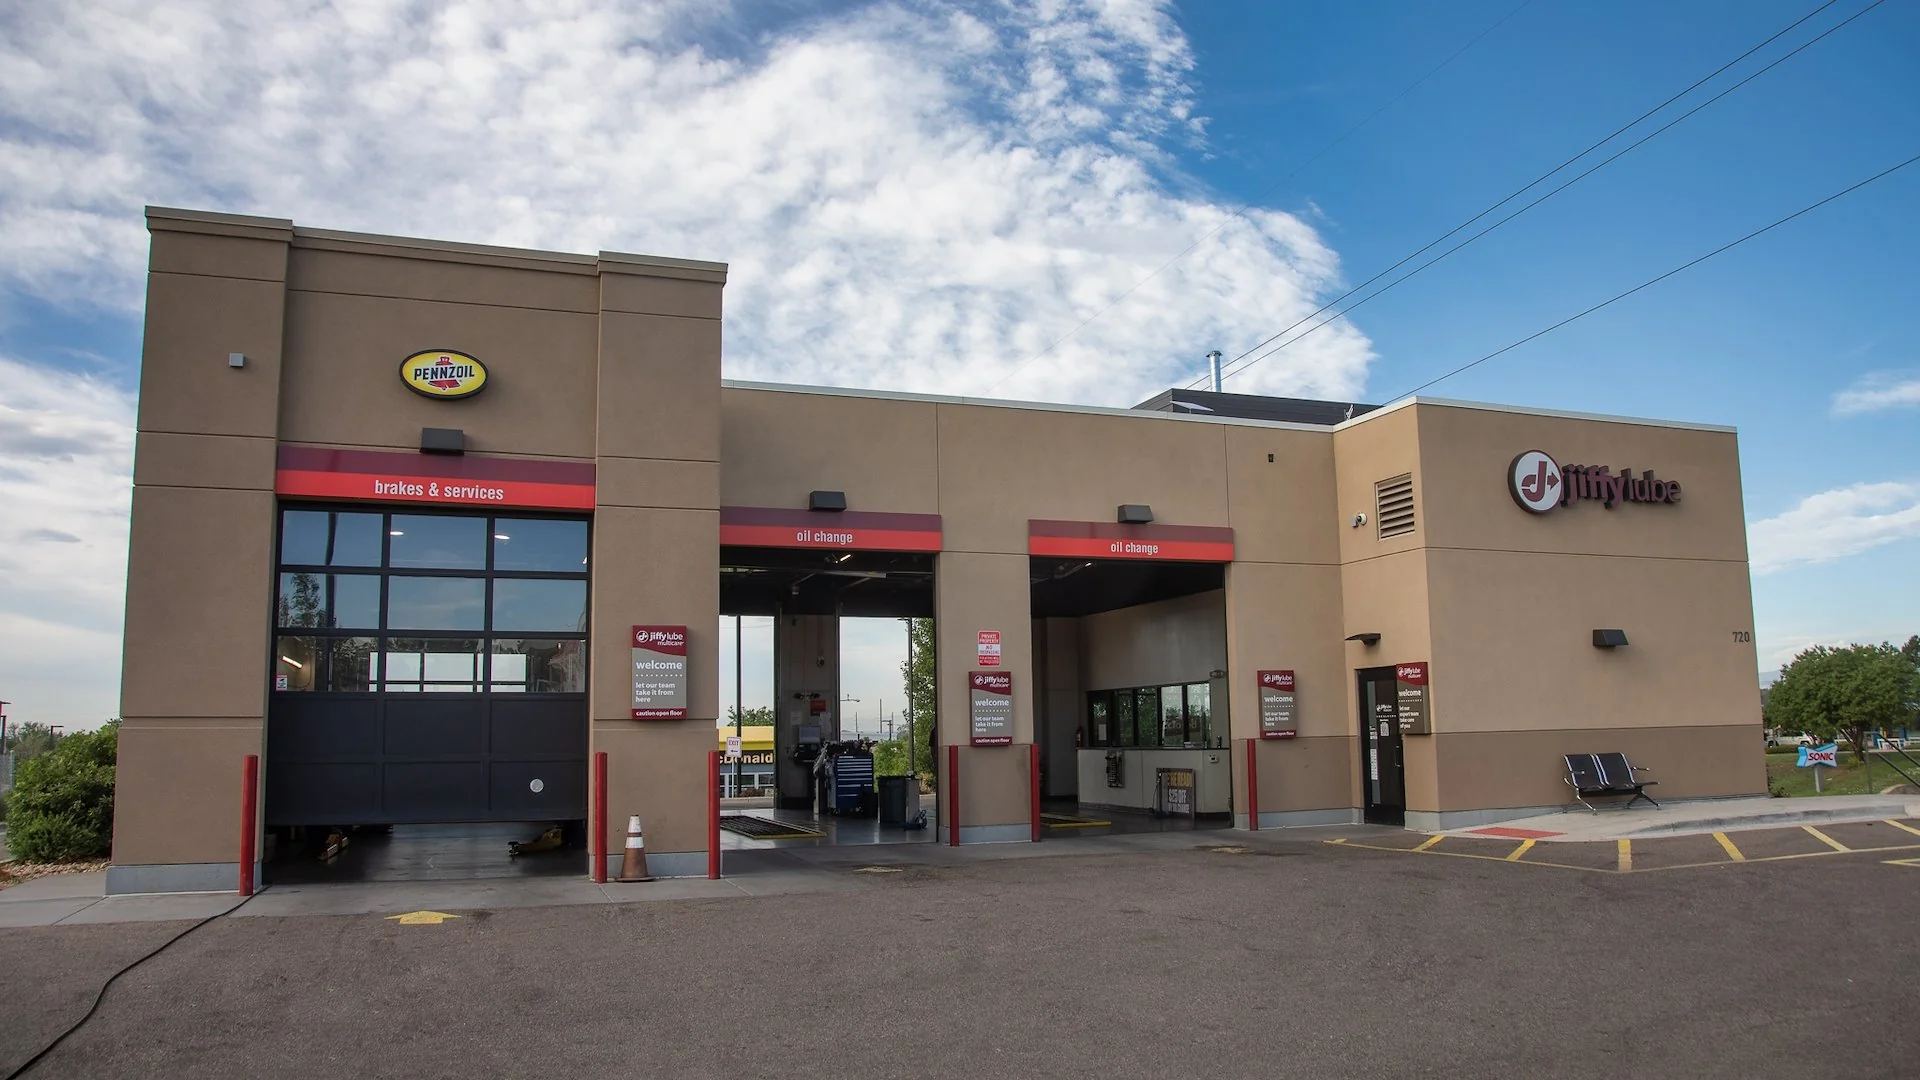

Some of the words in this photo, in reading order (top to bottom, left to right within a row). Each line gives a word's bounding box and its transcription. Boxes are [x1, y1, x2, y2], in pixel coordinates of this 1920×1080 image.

[414, 365, 475, 381] PENNZOIL
[375, 480, 424, 496] brakes
[429, 482, 439, 497] &
[444, 485, 504, 500] services
[797, 530, 811, 542] oil
[814, 530, 853, 545] change
[1111, 541, 1123, 553] oil
[1125, 542, 1159, 556] change
[1732, 631, 1750, 643] 720
[636, 660, 683, 670] welcome
[1398, 689, 1421, 697] welcome
[975, 698, 1010, 706] welcome
[1264, 695, 1293, 703] welcome
[1808, 752, 1834, 761] SONIC
